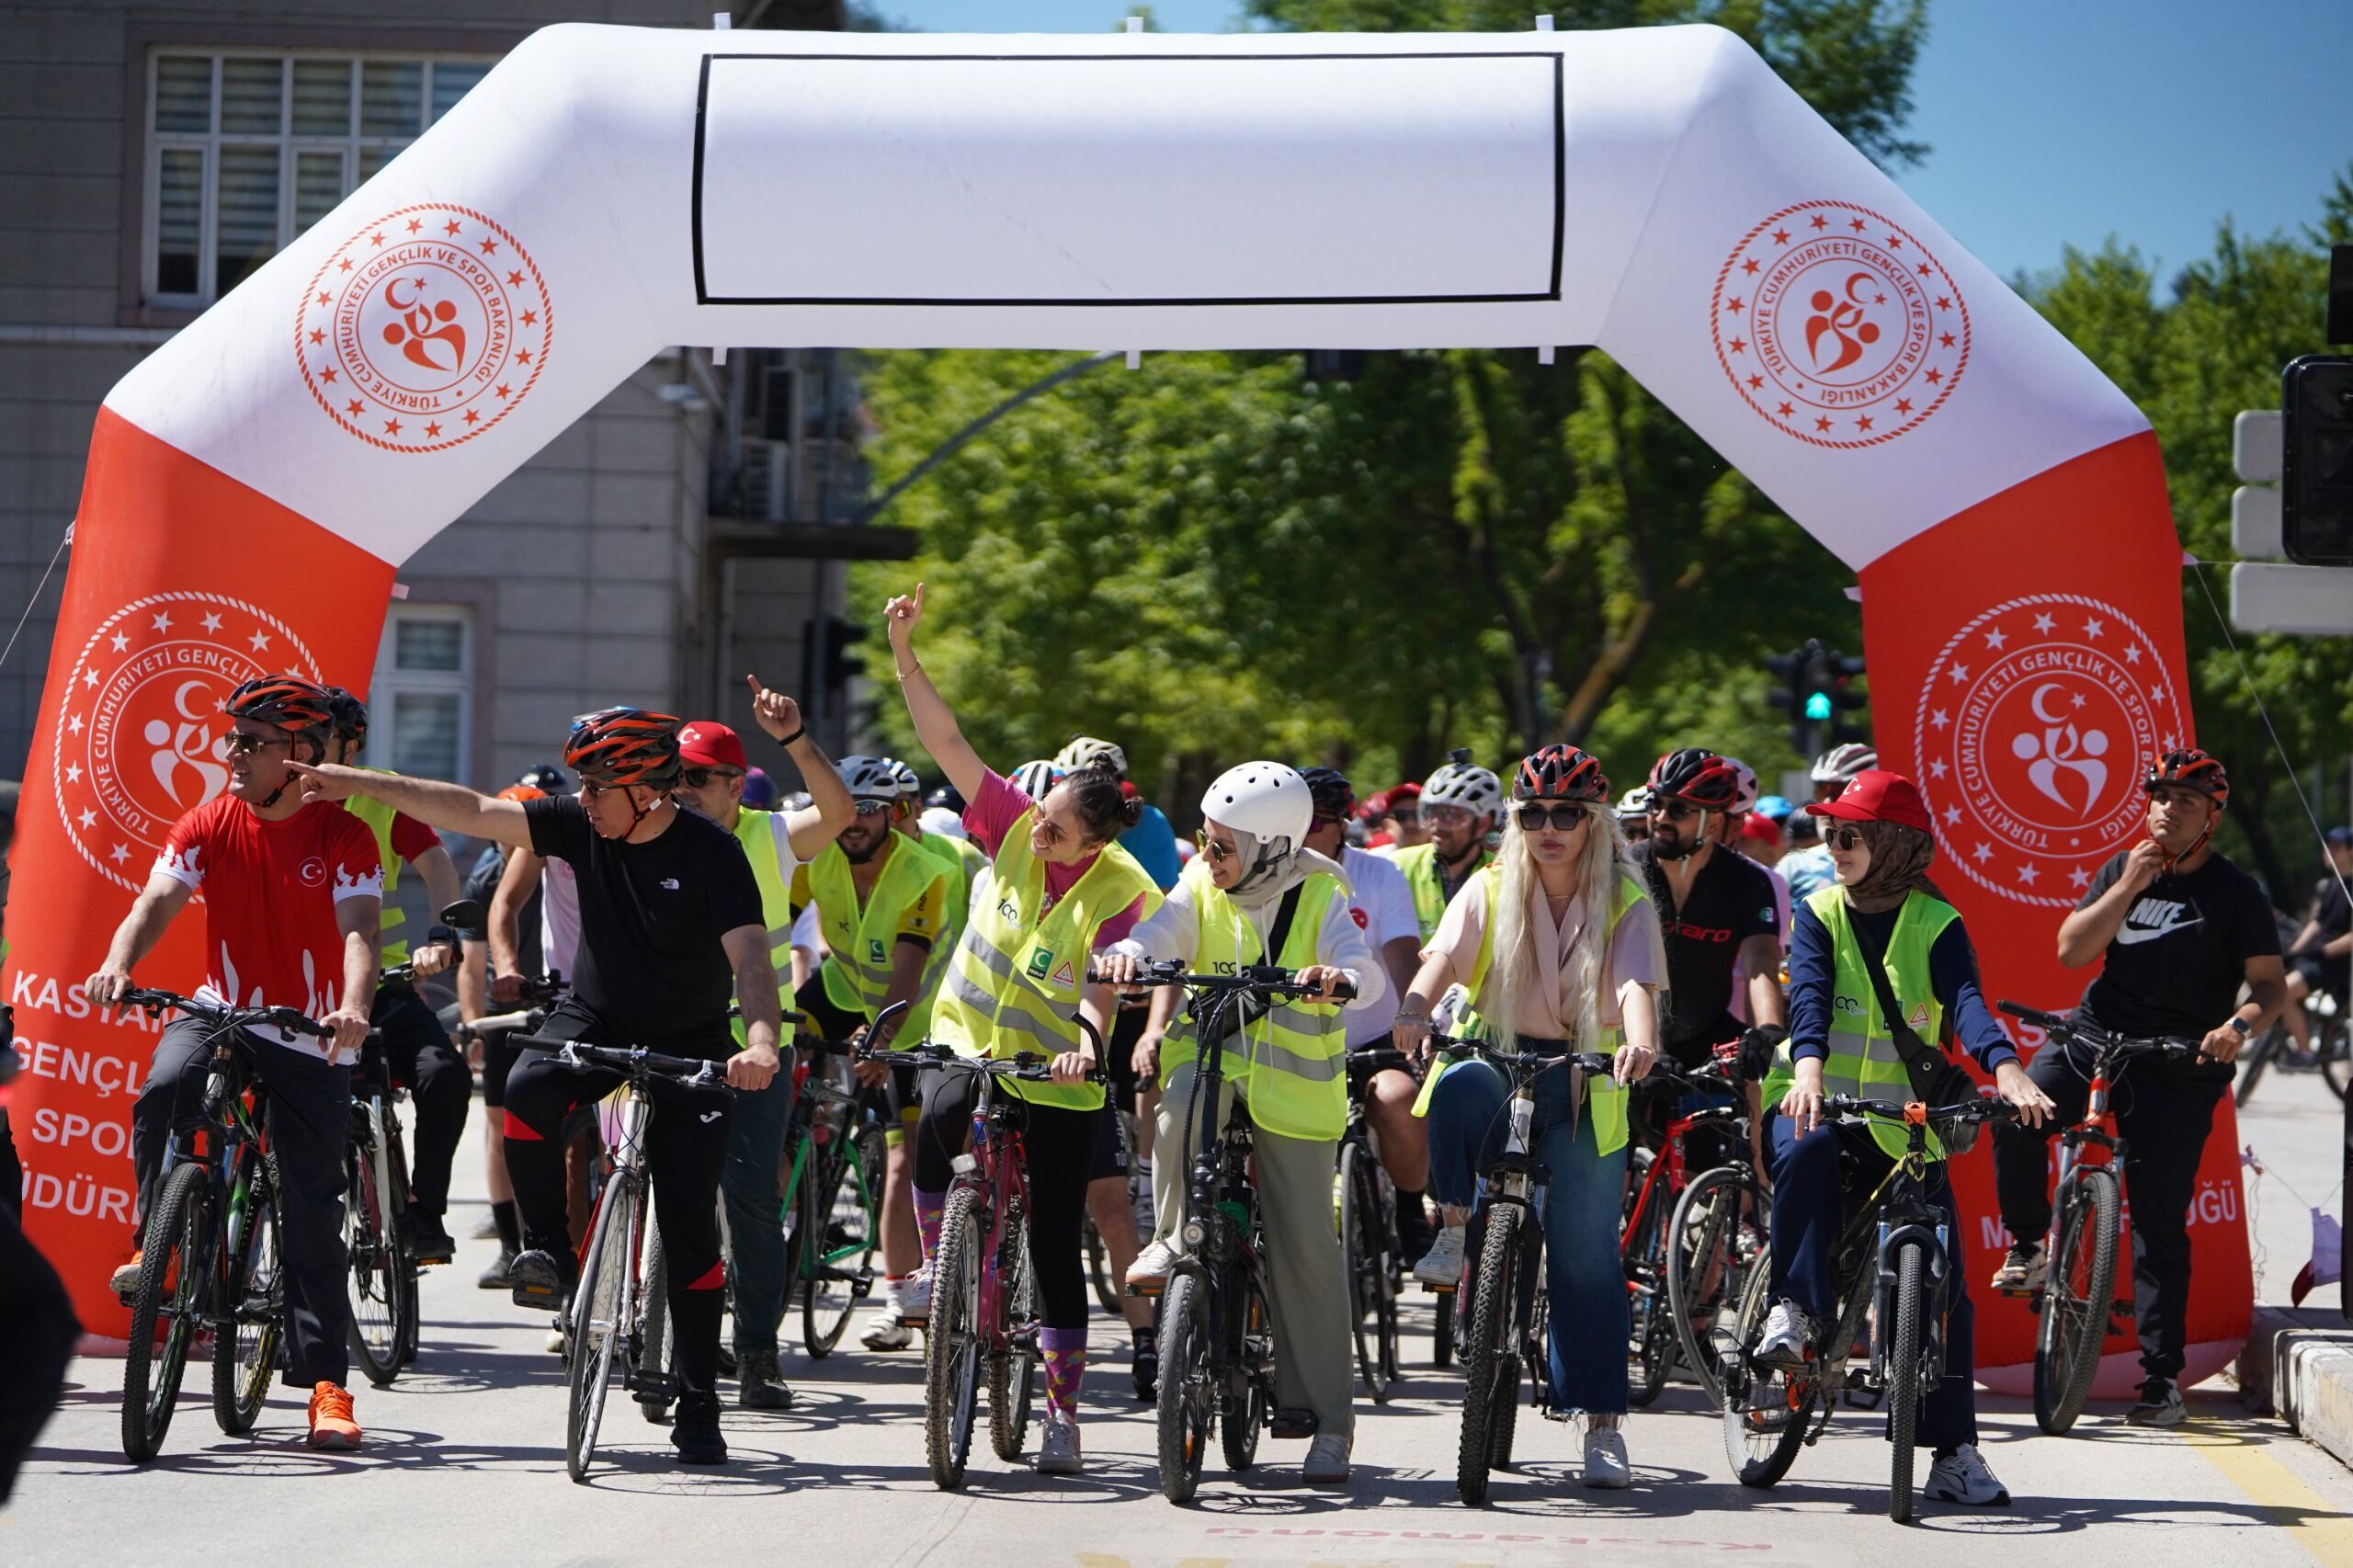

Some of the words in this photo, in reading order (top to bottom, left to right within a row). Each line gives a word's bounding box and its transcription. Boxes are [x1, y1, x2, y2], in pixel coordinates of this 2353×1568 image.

[368, 244, 432, 278] GENÇLİK
[438, 247, 457, 265] VE
[458, 258, 494, 296] SPOR
[1764, 242, 1858, 305] CUMHURİYETİ
[1860, 248, 1917, 298] GENÇLİK
[340, 275, 372, 383] CUMHURİYETİ
[1910, 299, 1925, 319] VE
[473, 296, 506, 384] BAKANLIĞI
[1757, 308, 1787, 376] TÜRKİYE
[1903, 324, 1926, 363] SPOR
[371, 381, 441, 411] TÜRKİYE
[1821, 364, 1908, 404] BAKANLIĞI
[2020, 651, 2106, 677] GENÇLİK
[2107, 670, 2129, 695] VE
[95, 648, 173, 759] CUMHURİYETİ
[1961, 661, 2019, 791] CUMHURİYETİ
[2124, 693, 2152, 745] SPOR
[97, 763, 149, 835] TÜRKİYE
[1976, 791, 2049, 848] TÜRKİYE
[2129, 898, 2188, 927] NIKE
